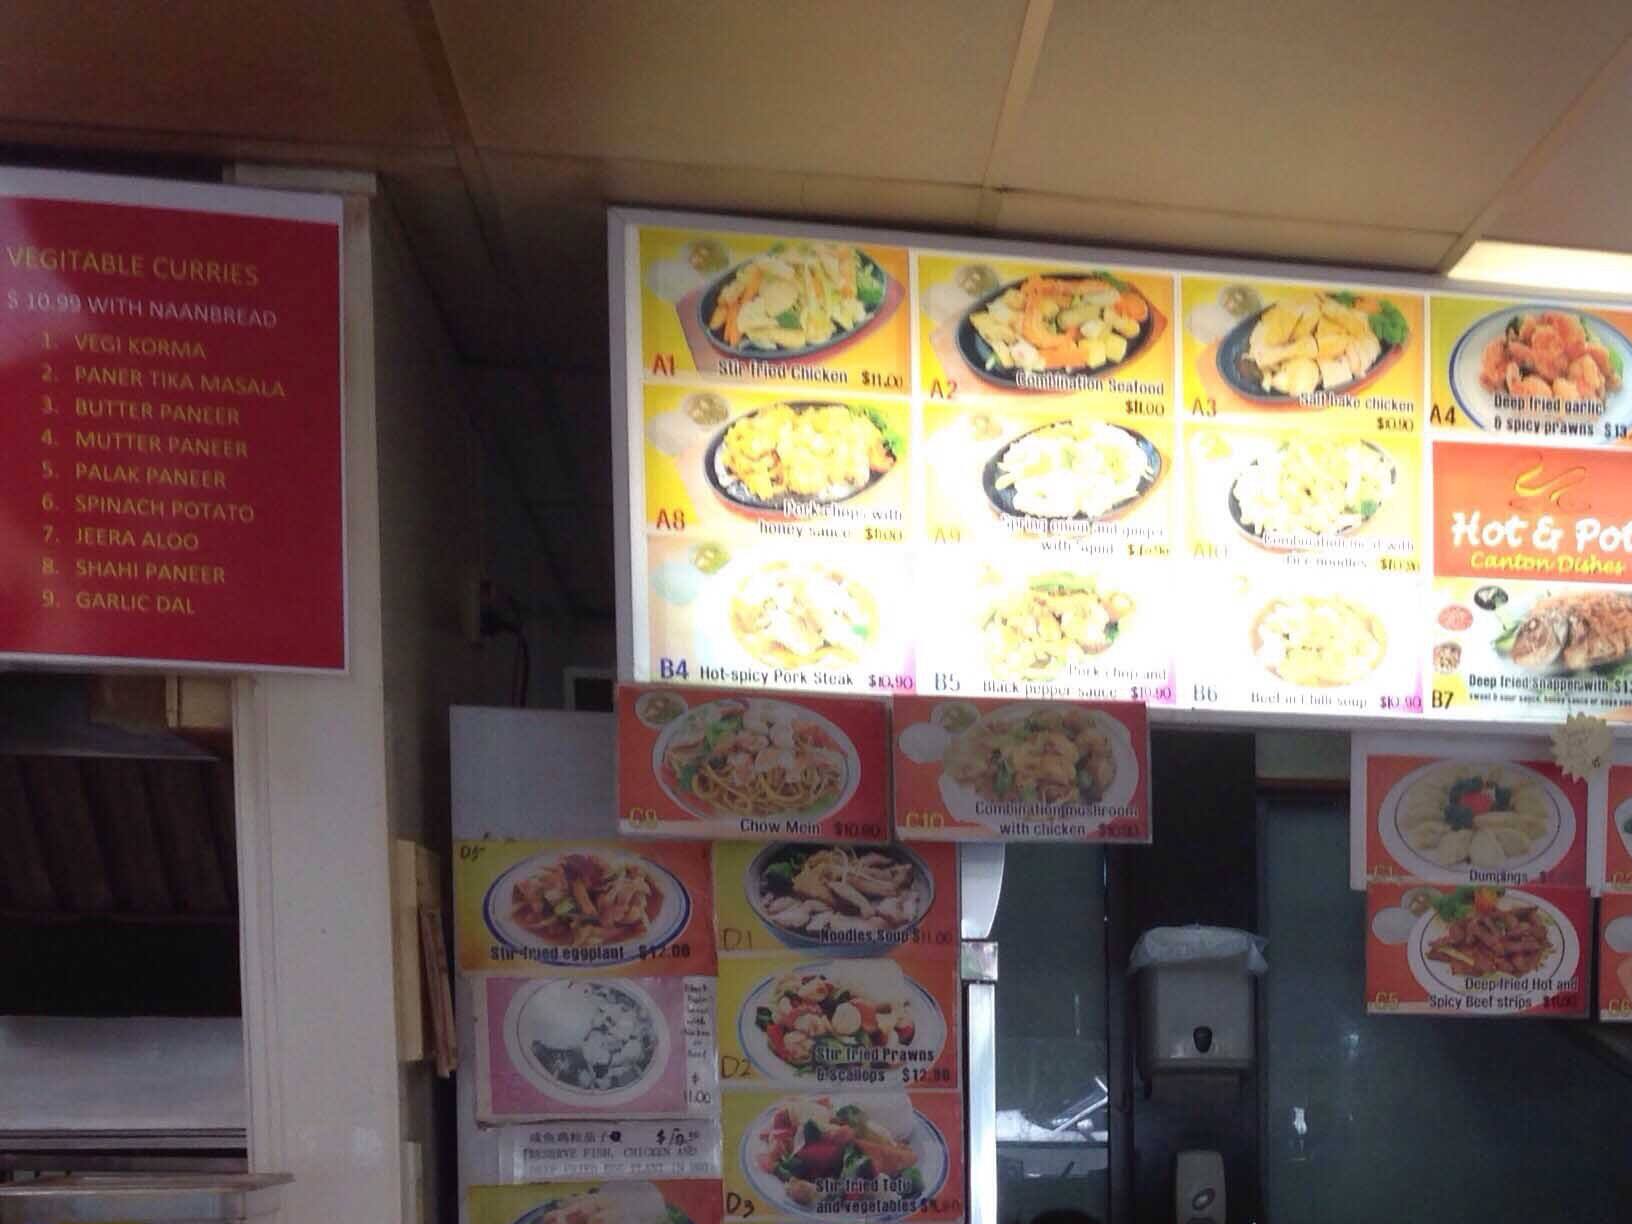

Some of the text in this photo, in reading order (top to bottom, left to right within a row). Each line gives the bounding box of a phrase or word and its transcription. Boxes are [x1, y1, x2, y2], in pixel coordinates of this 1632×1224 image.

[7, 246, 260, 286] VEGITABLE CURRIES
[87, 296, 278, 329] WITH NAANBREAD
[74, 335, 123, 353] VEGI
[128, 338, 208, 360] KORMA
[75, 366, 143, 388] PANER
[150, 372, 194, 392] TIKA
[200, 376, 287, 398] MASALA
[75, 399, 154, 420] BUTTER
[159, 403, 240, 426] PANEER
[76, 431, 162, 453] MUTTER
[168, 436, 249, 458] PANEER
[76, 464, 140, 484] PALAK
[146, 467, 226, 490] PANEER
[75, 495, 166, 518] SPINACH
[171, 501, 255, 523] POTATO
[77, 527, 136, 548] JEERA
[141, 533, 199, 551] ALOO
[1451, 510, 1528, 548] Hot
[1532, 515, 1564, 553] &
[76, 559, 139, 579] SHAHI
[145, 562, 226, 584] PANEER
[1470, 550, 1551, 570] Canton
[76, 591, 150, 613] GARLIC
[156, 596, 195, 615] DAL
[660, 658, 689, 681] B4
[1432, 689, 1454, 710] B7
[740, 818, 780, 833] Chow
